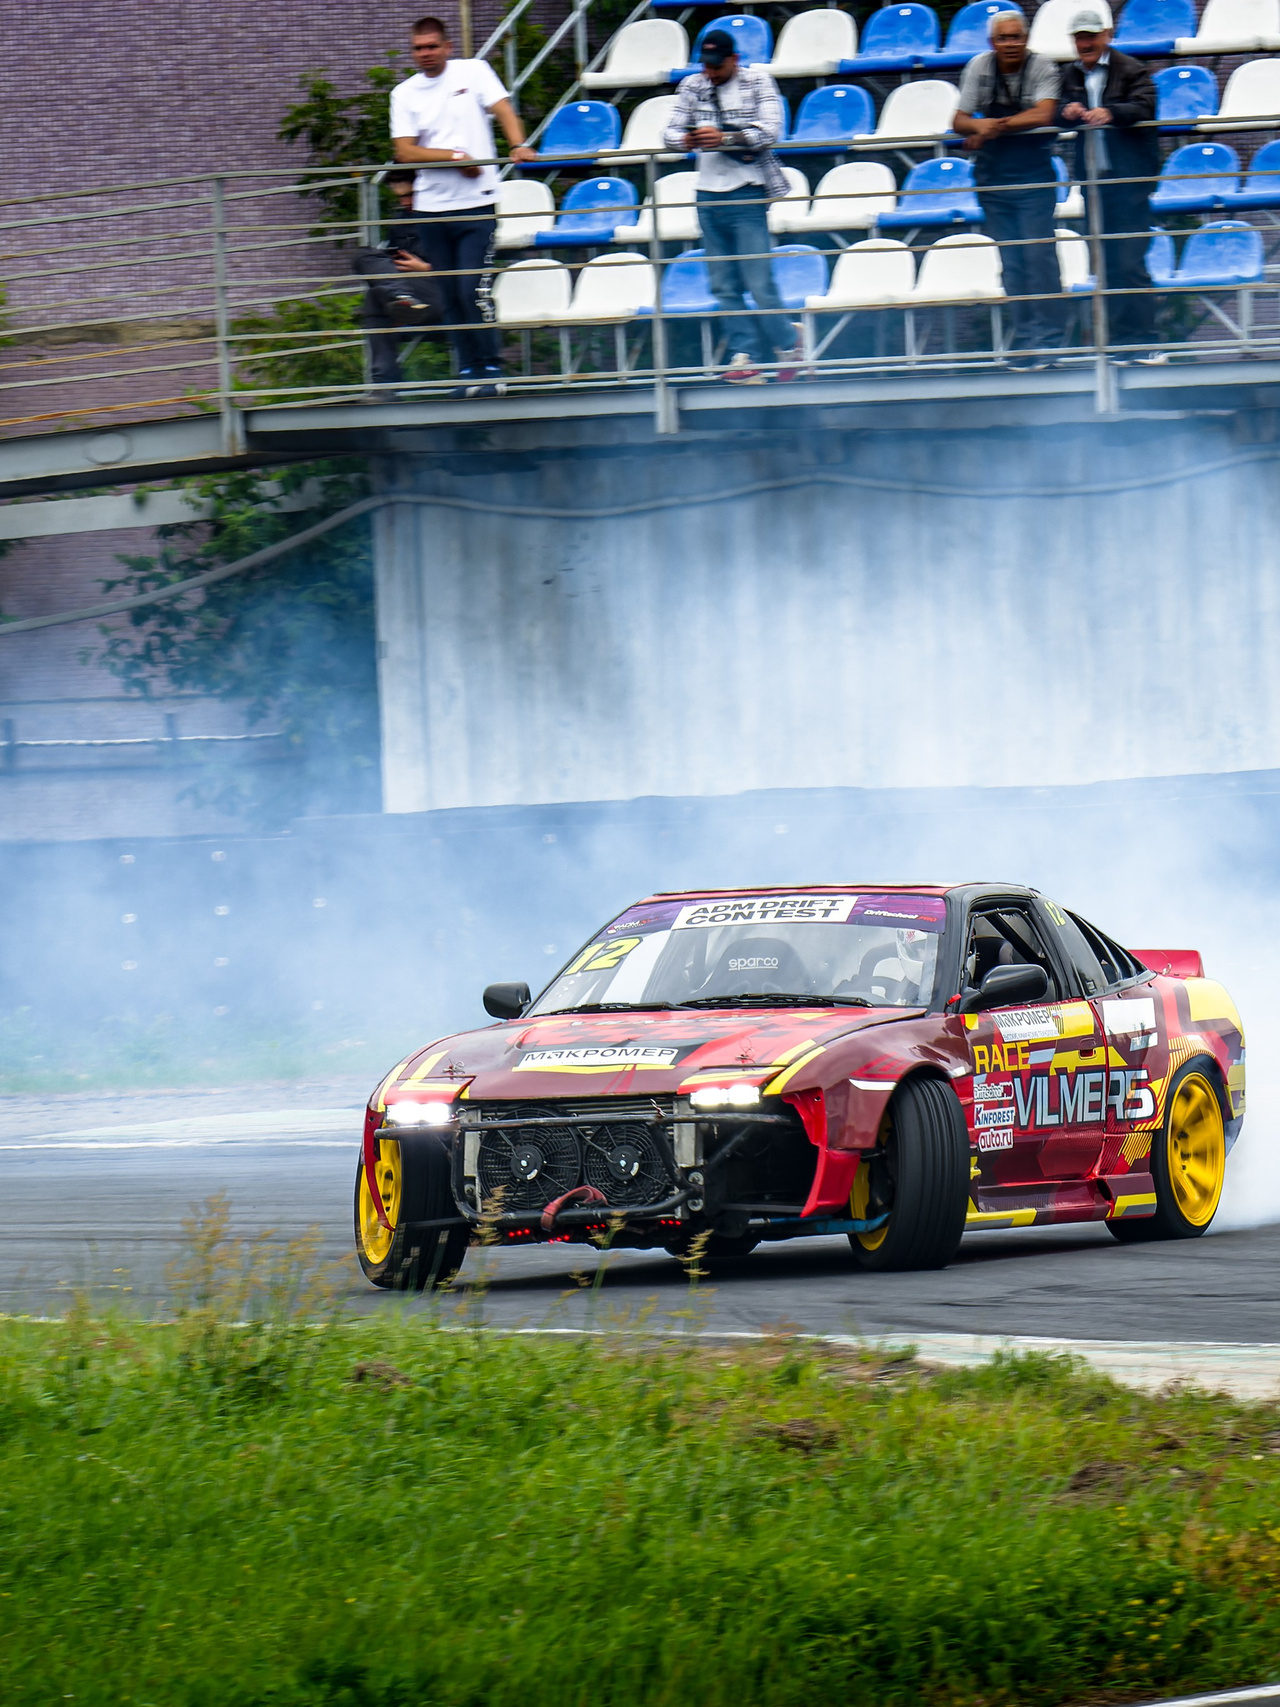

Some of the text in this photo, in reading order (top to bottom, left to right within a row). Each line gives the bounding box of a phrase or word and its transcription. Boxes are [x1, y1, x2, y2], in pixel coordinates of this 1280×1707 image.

[685, 908, 840, 925] CONTEST
[690, 899, 844, 916] ADM DRIFT
[1043, 901, 1066, 926] 12
[563, 936, 644, 977] 12
[728, 957, 778, 971] sparco
[972, 1041, 1031, 1074] RACE
[1013, 1068, 1156, 1127] VILMERS
[974, 1105, 1015, 1127] KINFOREST
[980, 1131, 1012, 1148] auto.ru
